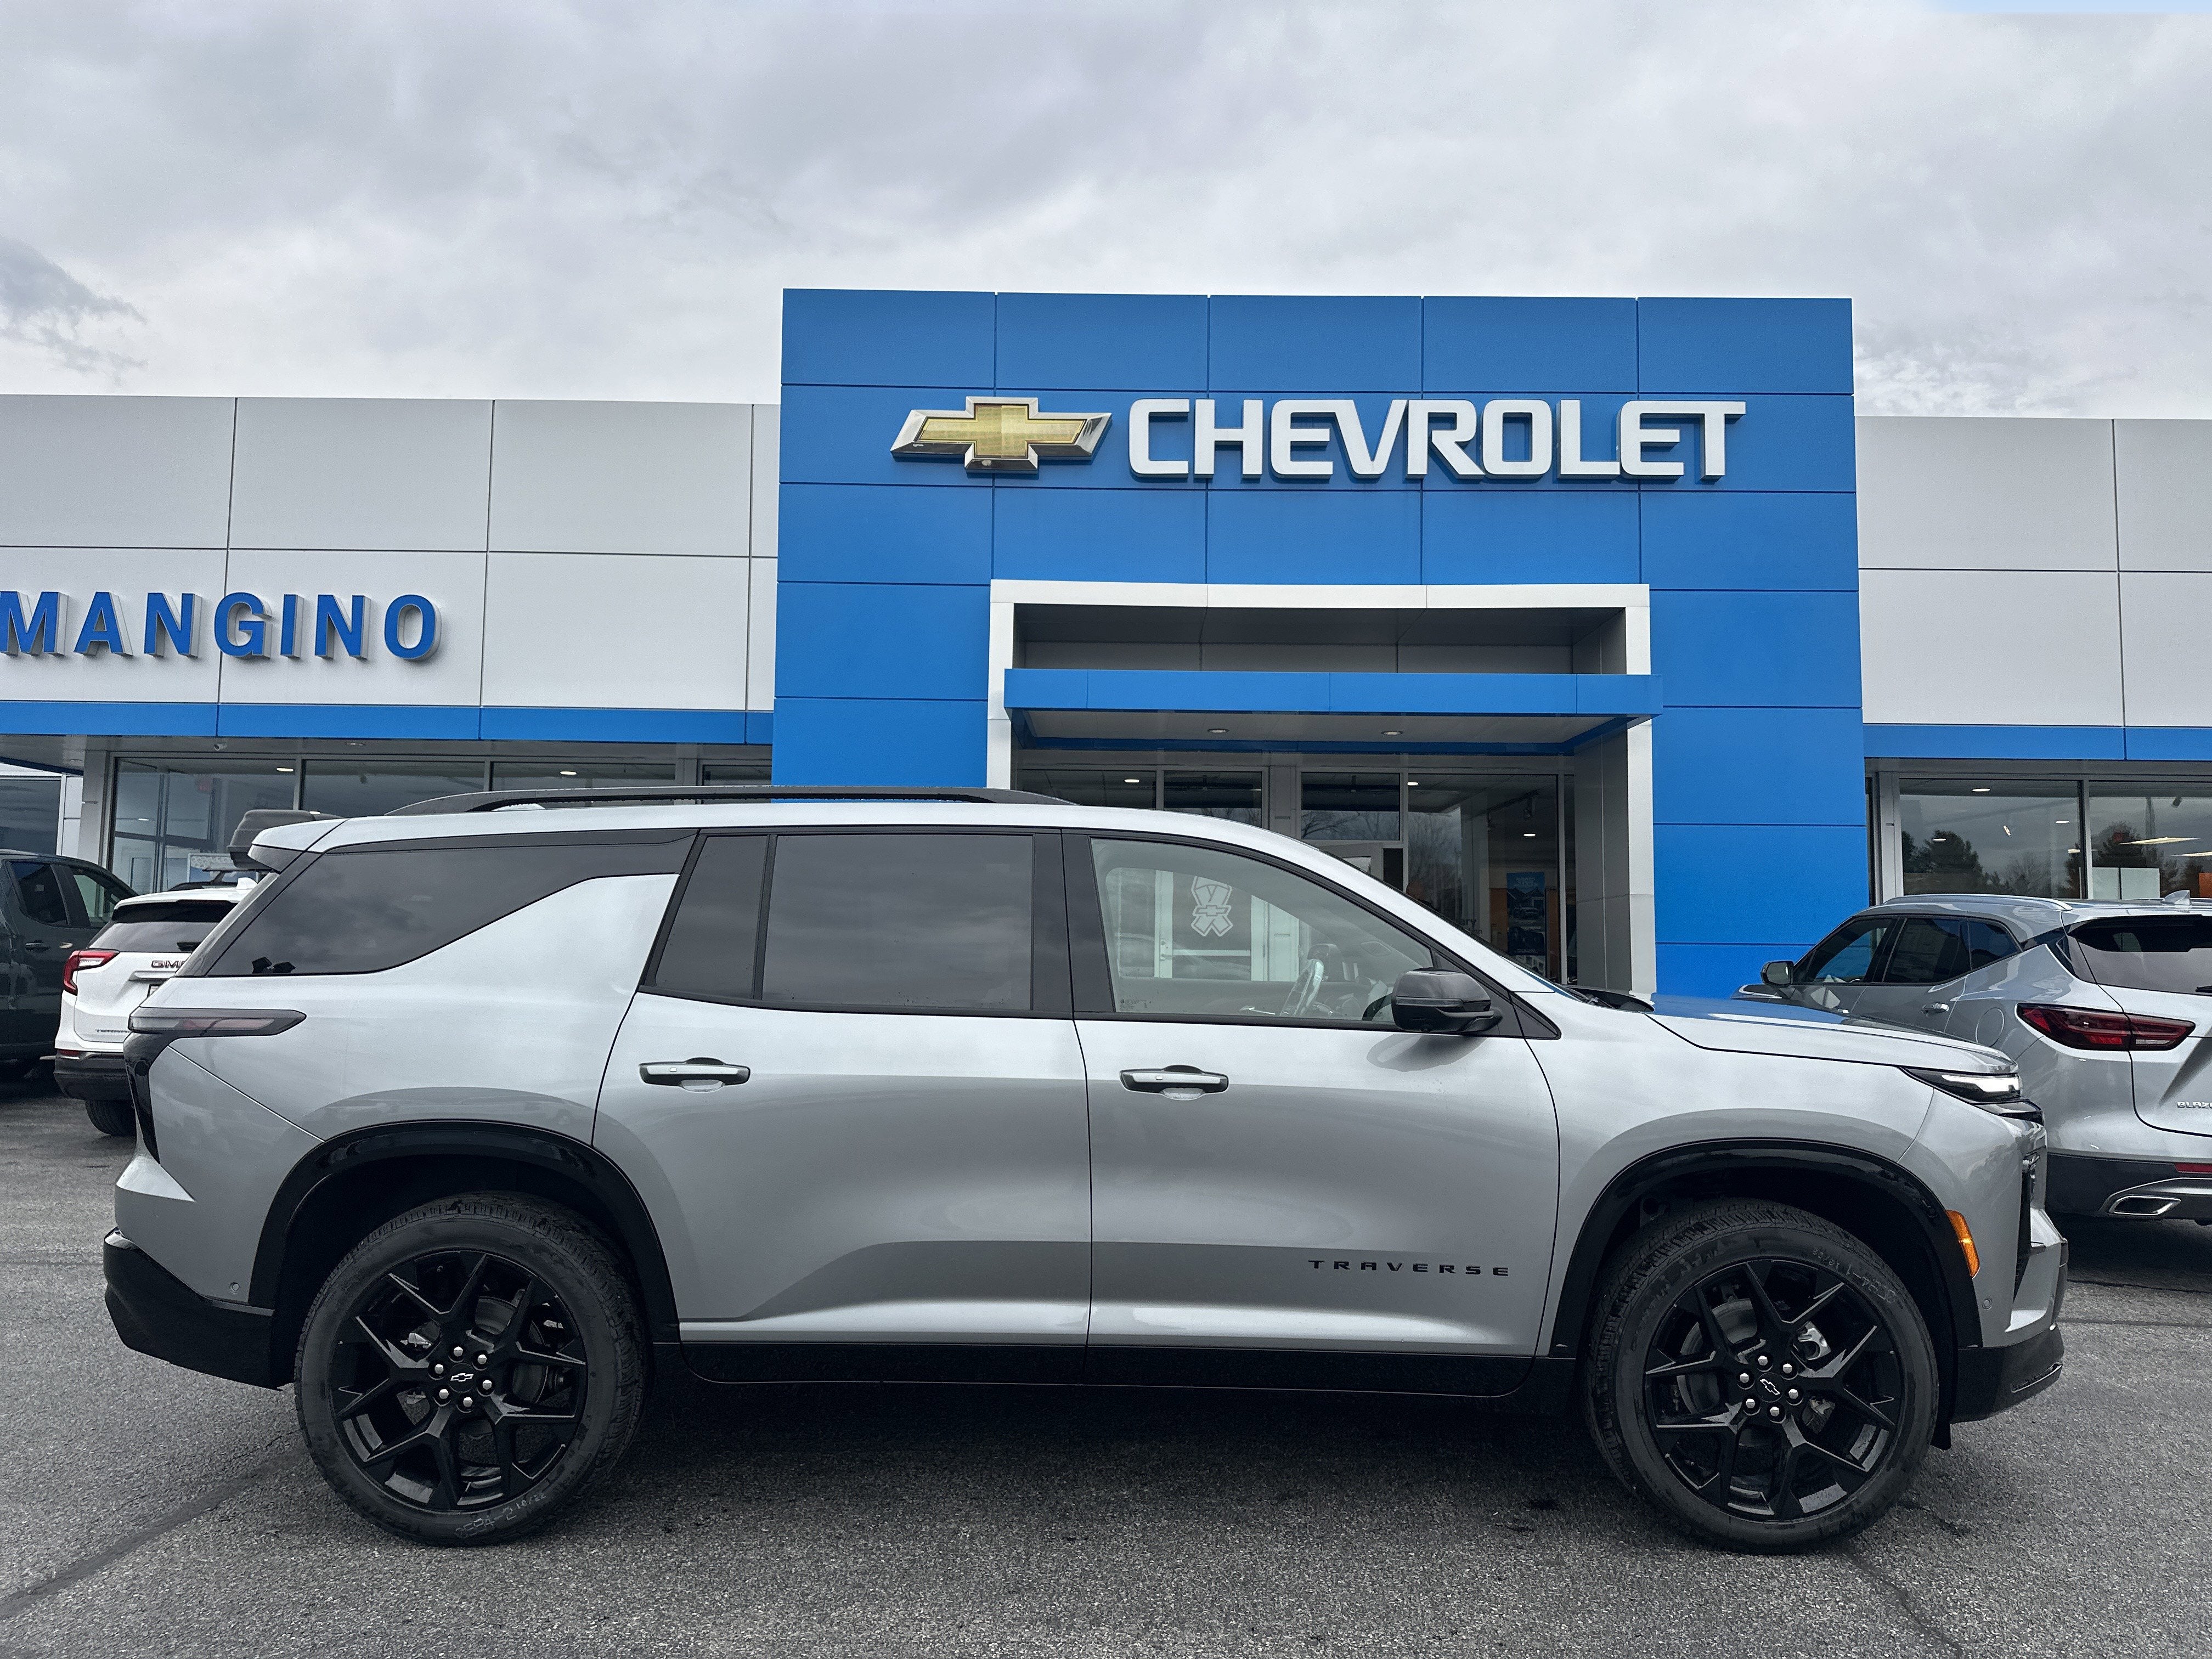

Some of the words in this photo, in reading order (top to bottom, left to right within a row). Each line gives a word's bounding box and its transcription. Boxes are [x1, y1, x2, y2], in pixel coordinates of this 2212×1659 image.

[1128, 398, 1746, 477] CHEVROLET
[0, 591, 439, 660] MANGINO
[1308, 1260, 1509, 1277] TRAVERSE
